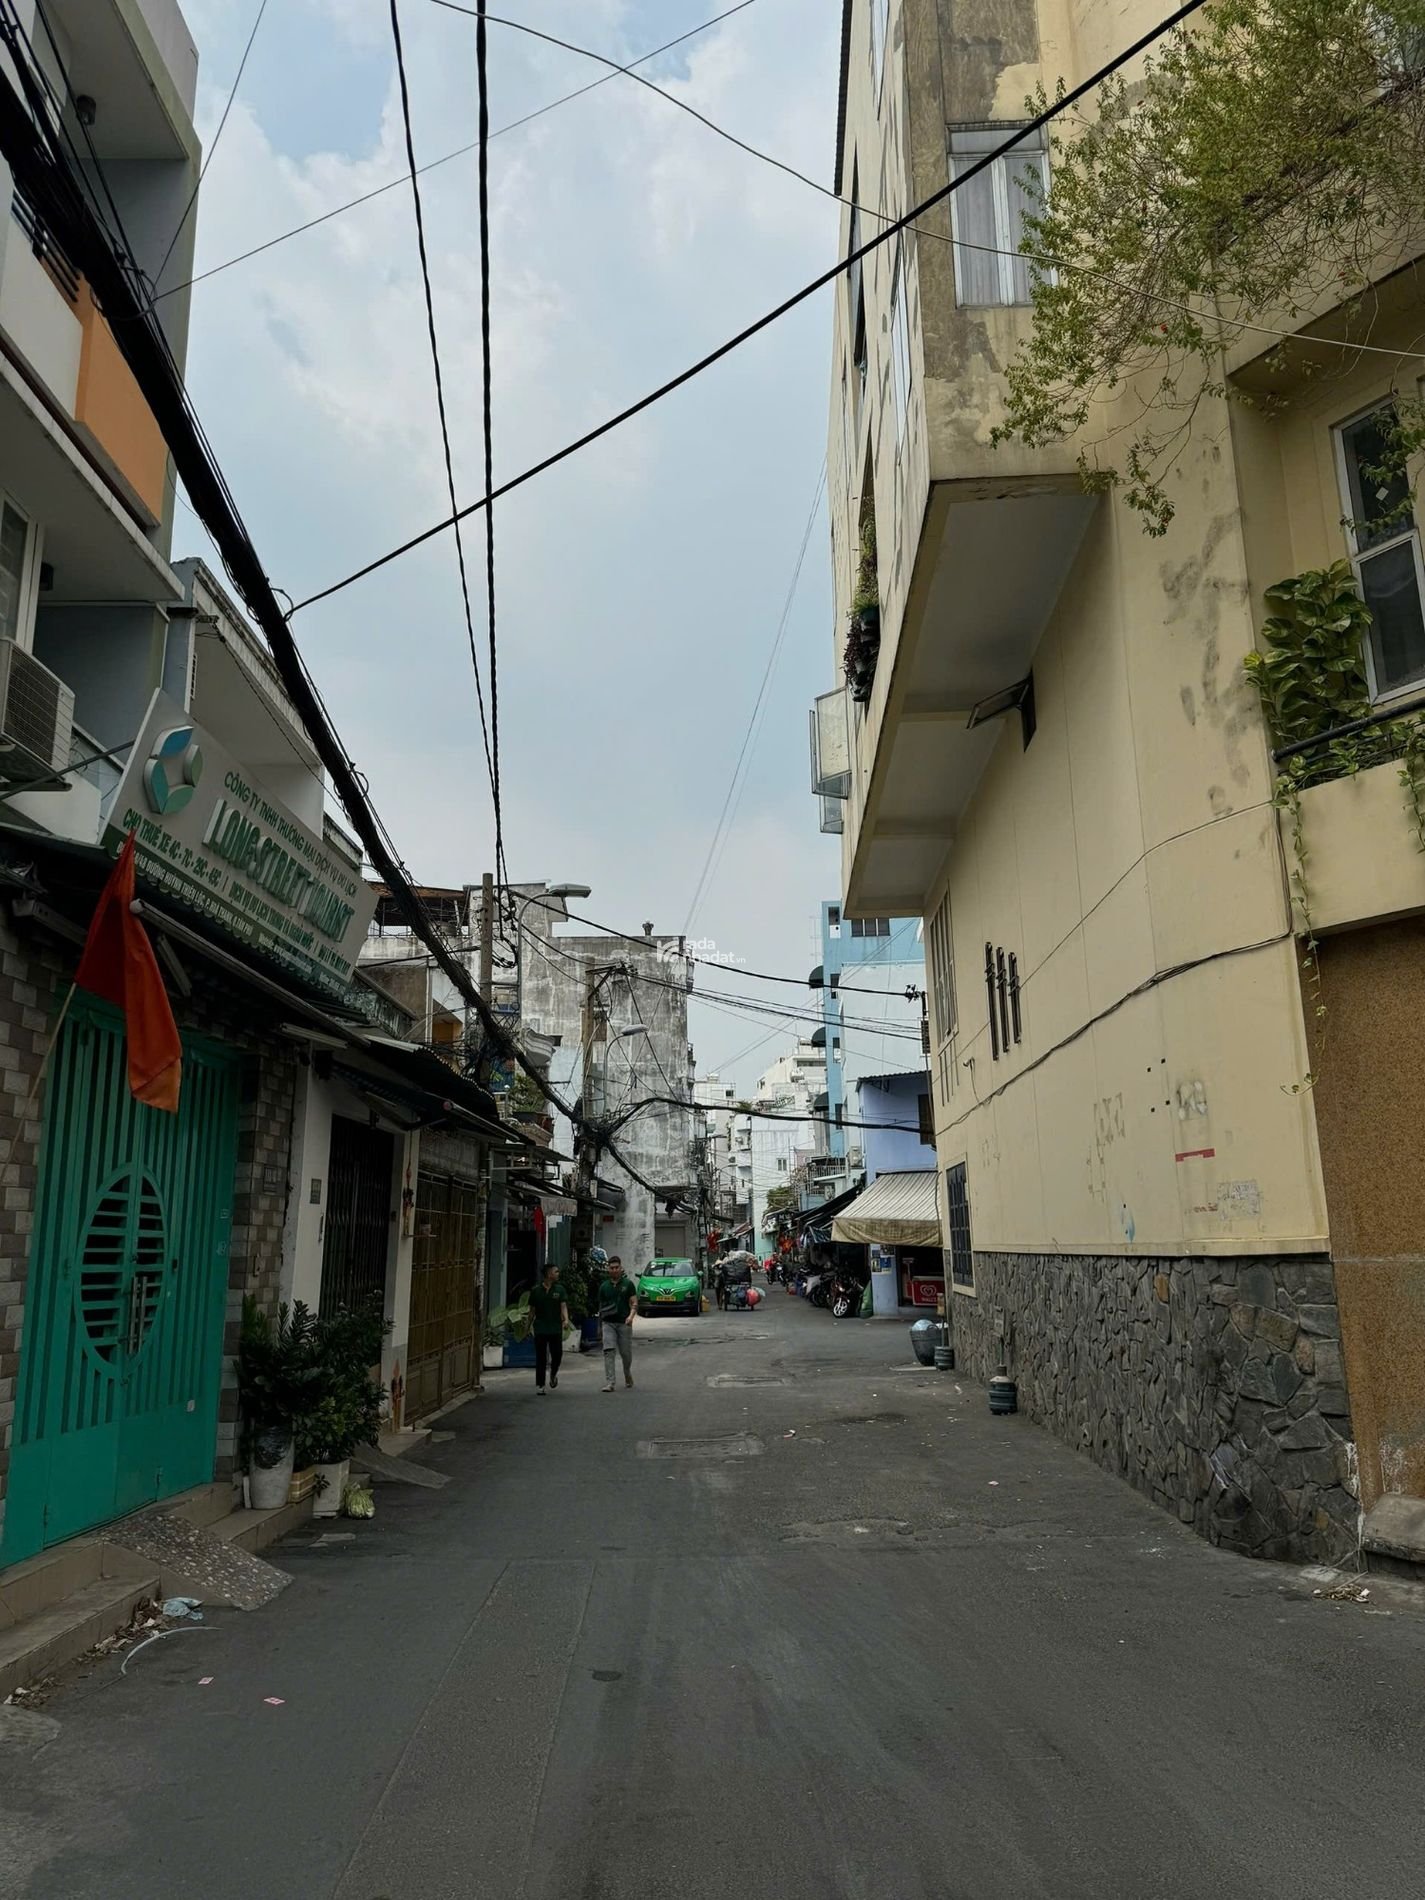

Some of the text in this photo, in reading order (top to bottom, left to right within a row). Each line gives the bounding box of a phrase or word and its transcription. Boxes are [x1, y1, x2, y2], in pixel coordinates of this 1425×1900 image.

[157, 832, 172, 854] XE
[224, 771, 251, 802] CÔNG
[249, 792, 261, 811] TY
[259, 801, 279, 828] TNHH
[277, 817, 304, 851] THƯƠNG
[203, 801, 260, 874] LONG
[249, 838, 309, 908] STREET
